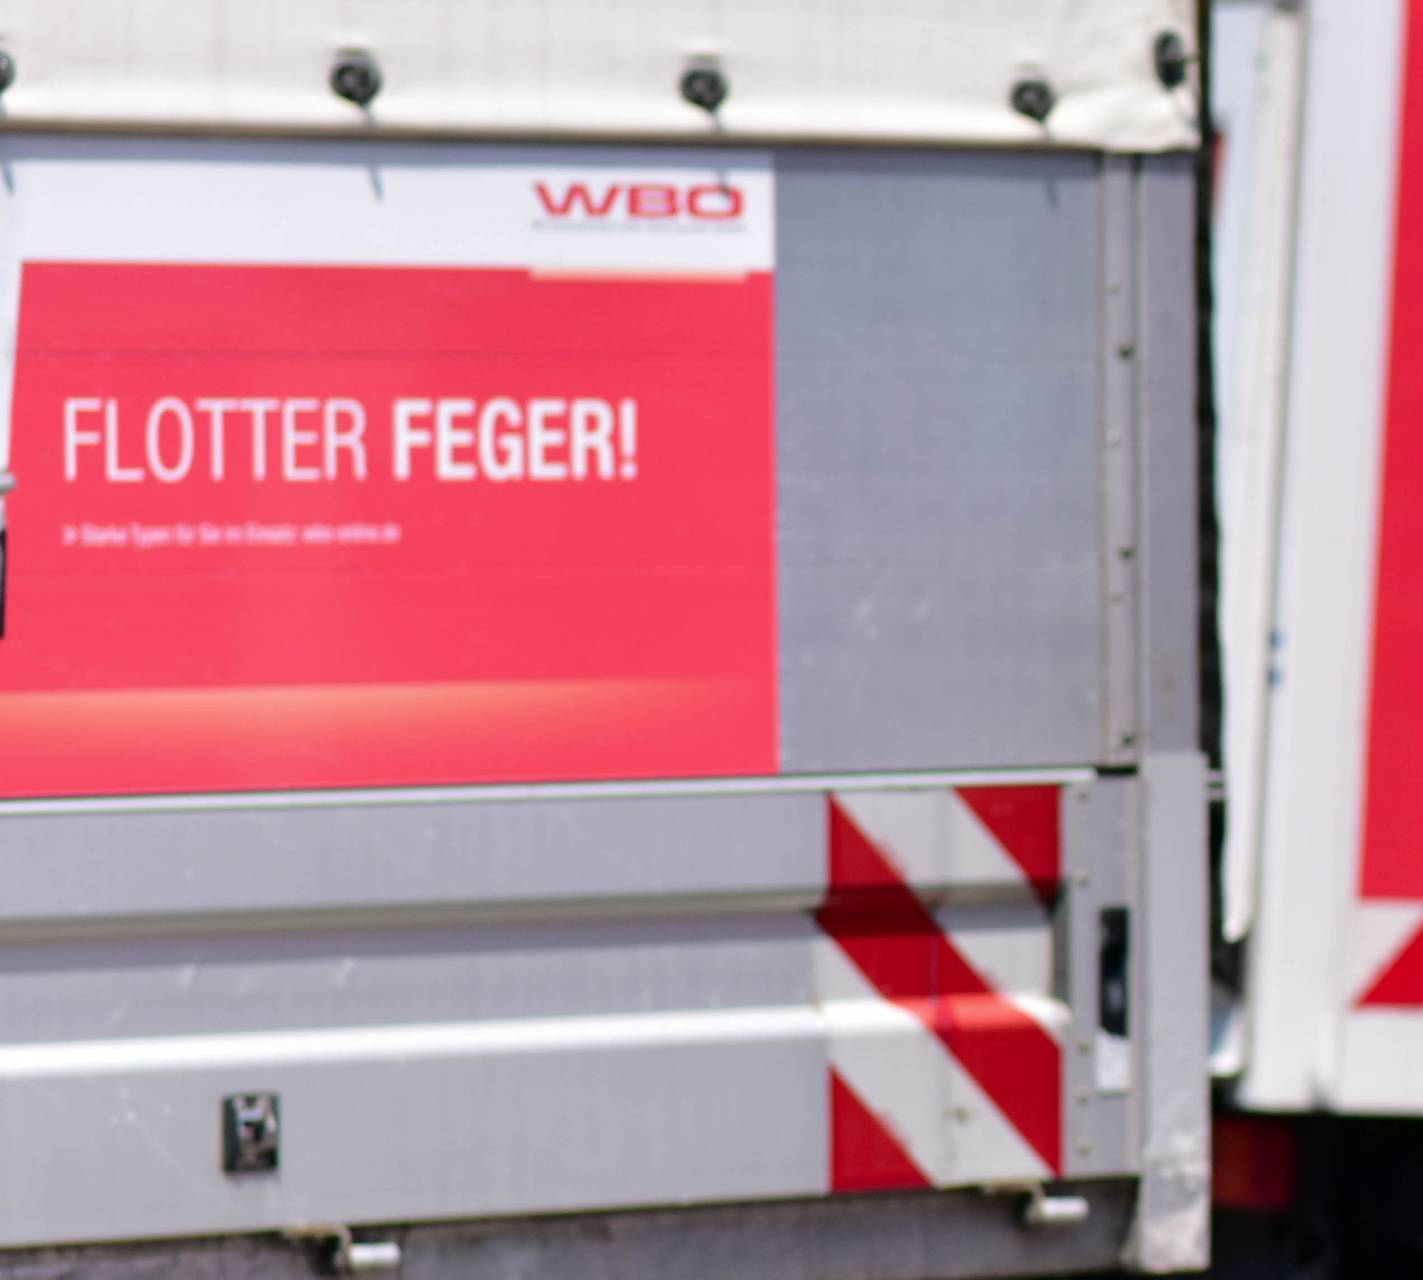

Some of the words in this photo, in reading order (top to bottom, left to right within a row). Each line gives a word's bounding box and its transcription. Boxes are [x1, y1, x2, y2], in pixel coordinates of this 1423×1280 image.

[535, 181, 744, 219] WBO
[63, 397, 367, 482] FLOTTER
[393, 397, 637, 482] FEGER!
